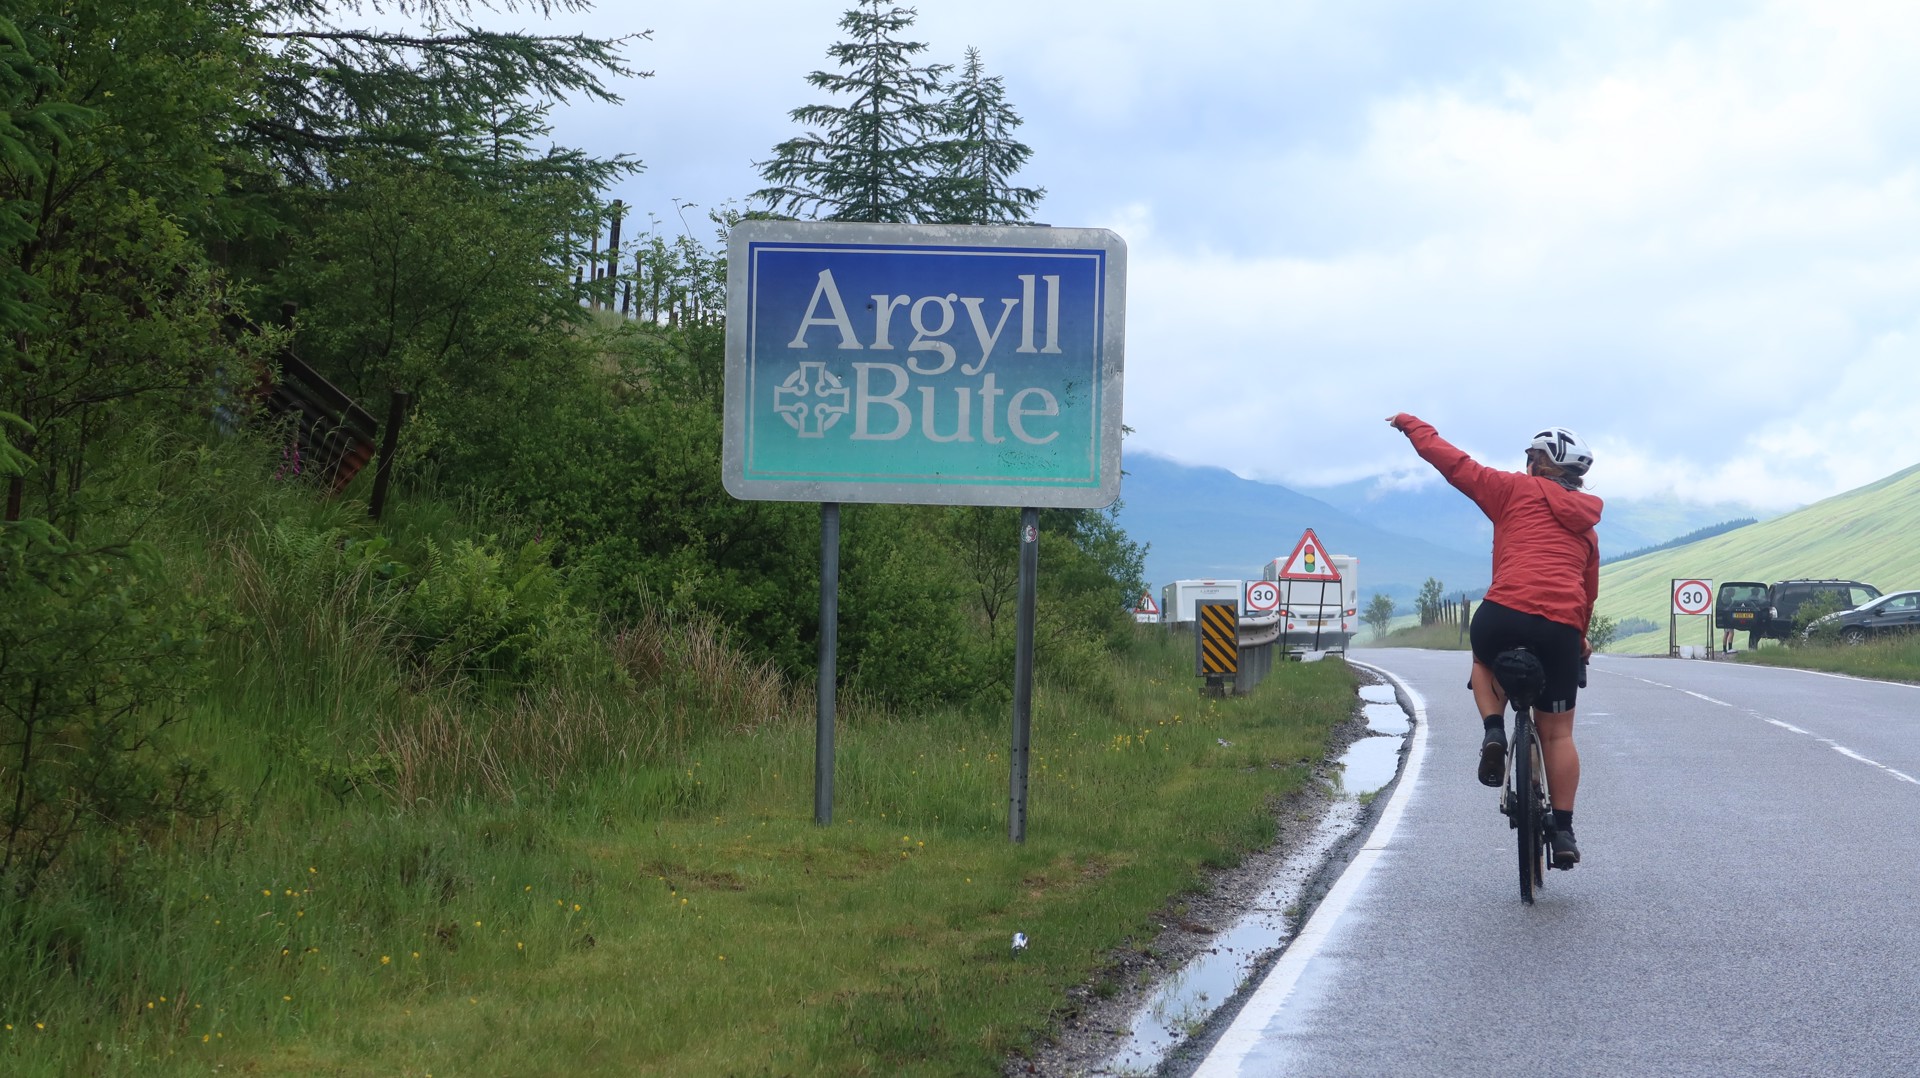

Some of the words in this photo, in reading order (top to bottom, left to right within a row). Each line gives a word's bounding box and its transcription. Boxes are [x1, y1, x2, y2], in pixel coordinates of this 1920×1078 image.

[787, 268, 1063, 376] Argyll
[850, 362, 1060, 445] Bute
[1254, 590, 1273, 601] 30
[1683, 591, 1703, 604] 30
